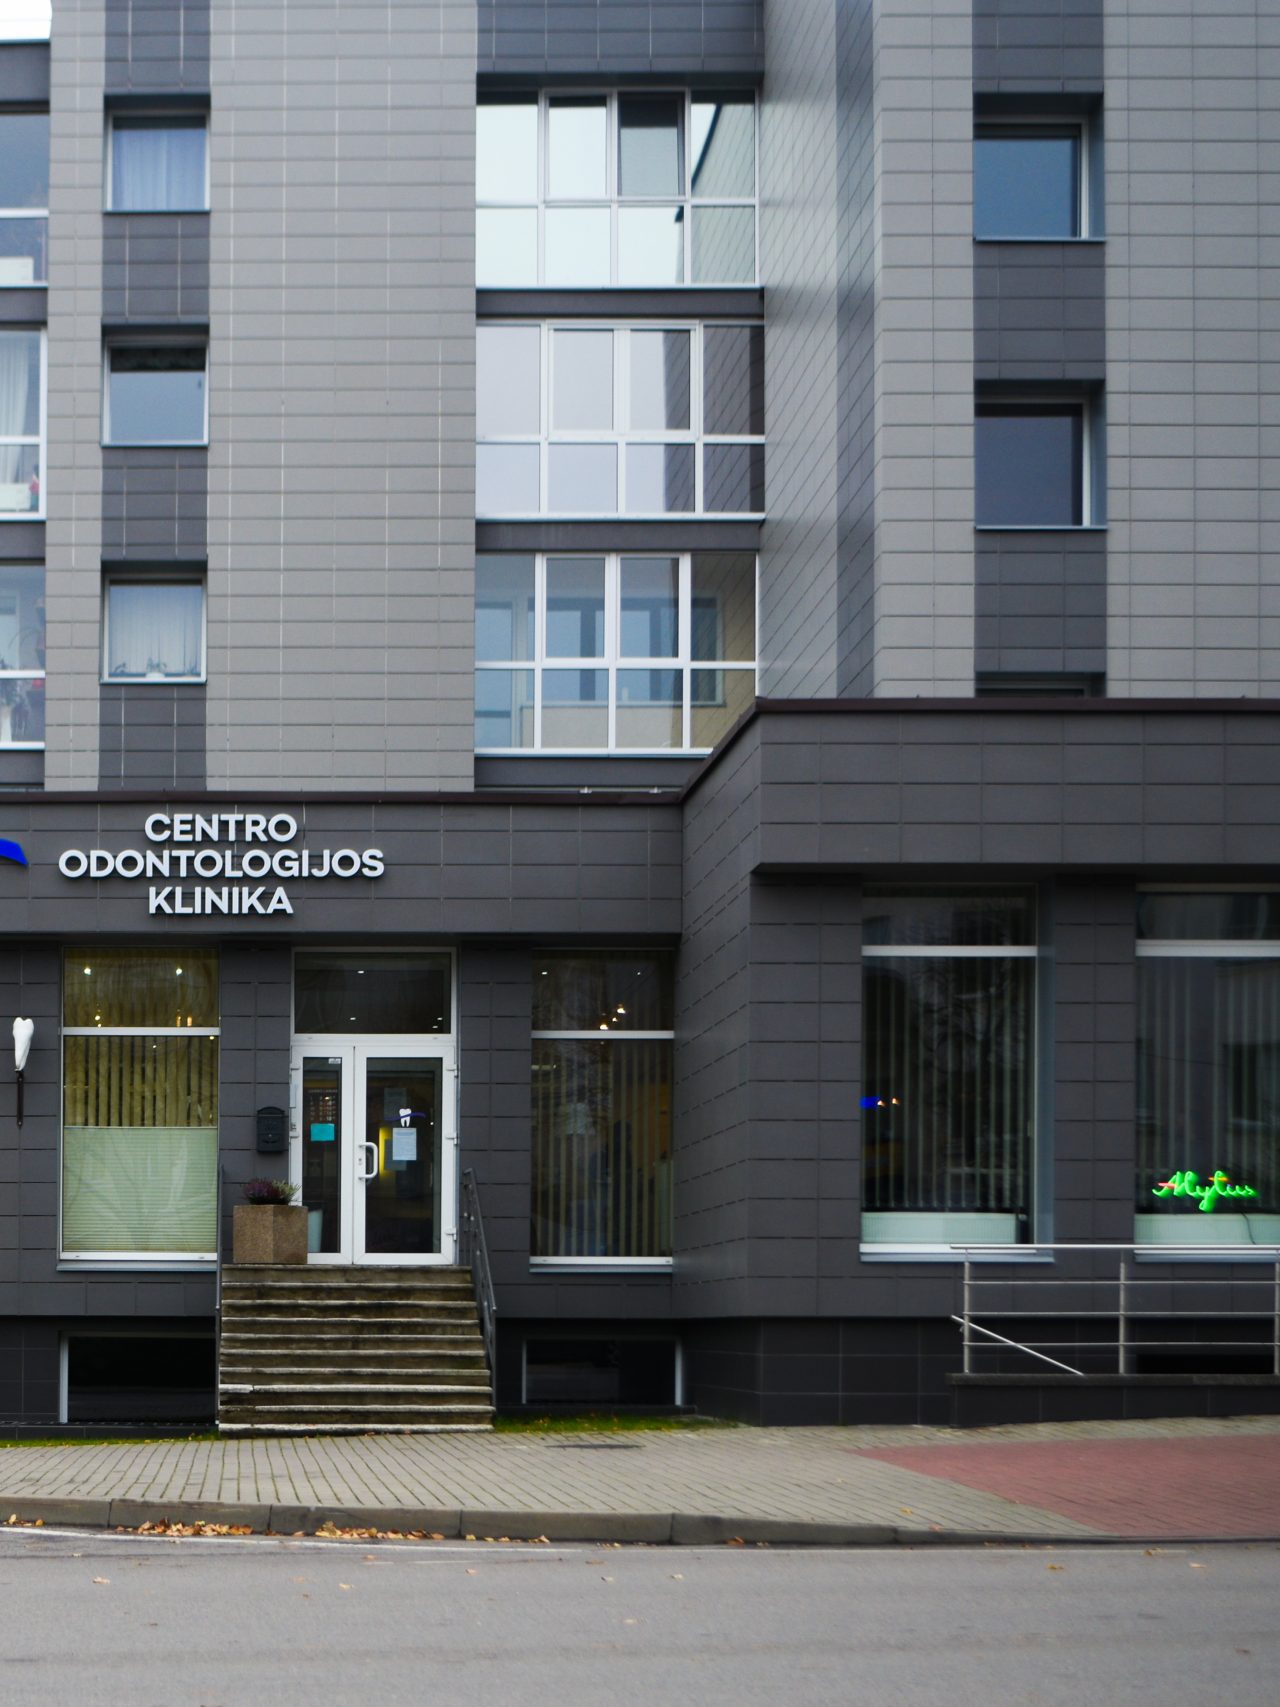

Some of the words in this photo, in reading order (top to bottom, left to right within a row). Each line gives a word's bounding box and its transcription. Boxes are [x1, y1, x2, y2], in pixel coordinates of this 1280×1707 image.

[144, 813, 298, 844] CENTRO
[58, 848, 385, 880] ODONTOLOGIJOS
[148, 886, 294, 915] KLINIKA
[1151, 1170, 1257, 1212] Alytus
